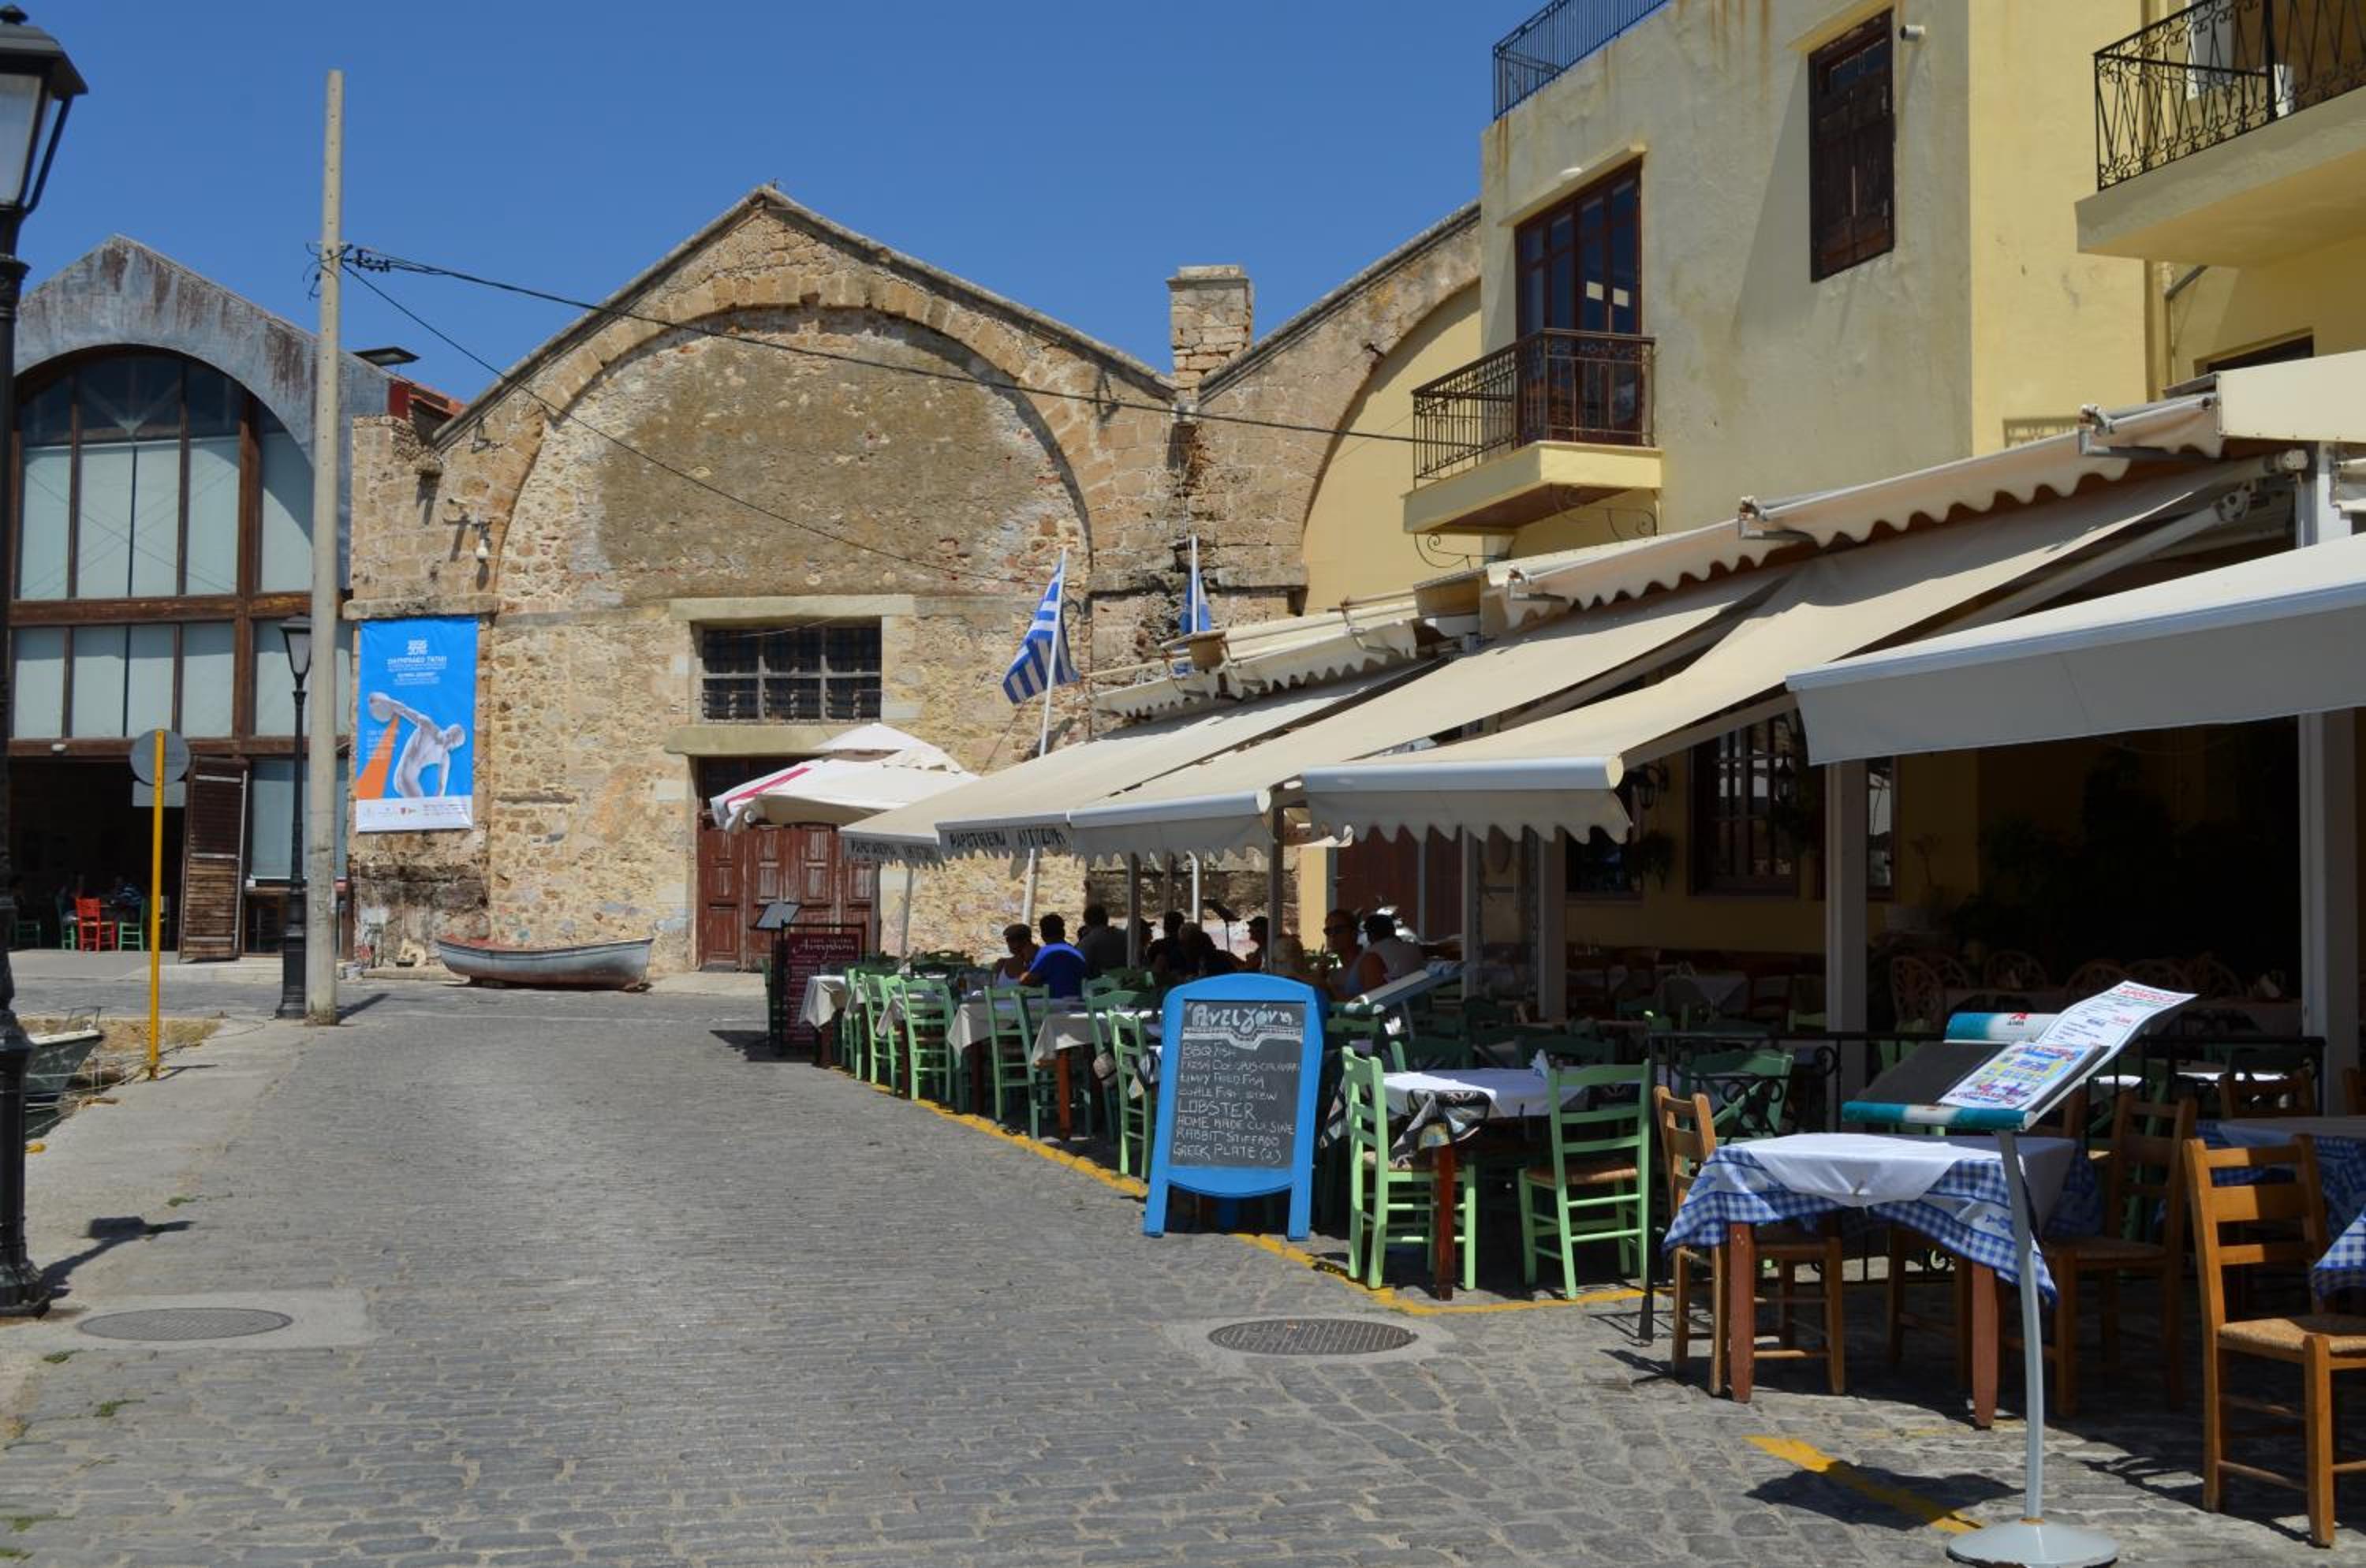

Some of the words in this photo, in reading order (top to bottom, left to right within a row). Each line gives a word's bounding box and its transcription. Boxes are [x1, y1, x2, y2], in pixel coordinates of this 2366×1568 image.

[1178, 1097, 1256, 1121] LOBSTER
[1177, 1114, 1211, 1129] HOME
[1214, 1118, 1244, 1130] MADE
[1176, 1126, 1224, 1141] RABBIT
[1173, 1141, 1212, 1161] GREEK
[1214, 1143, 1256, 1159] PLATE
